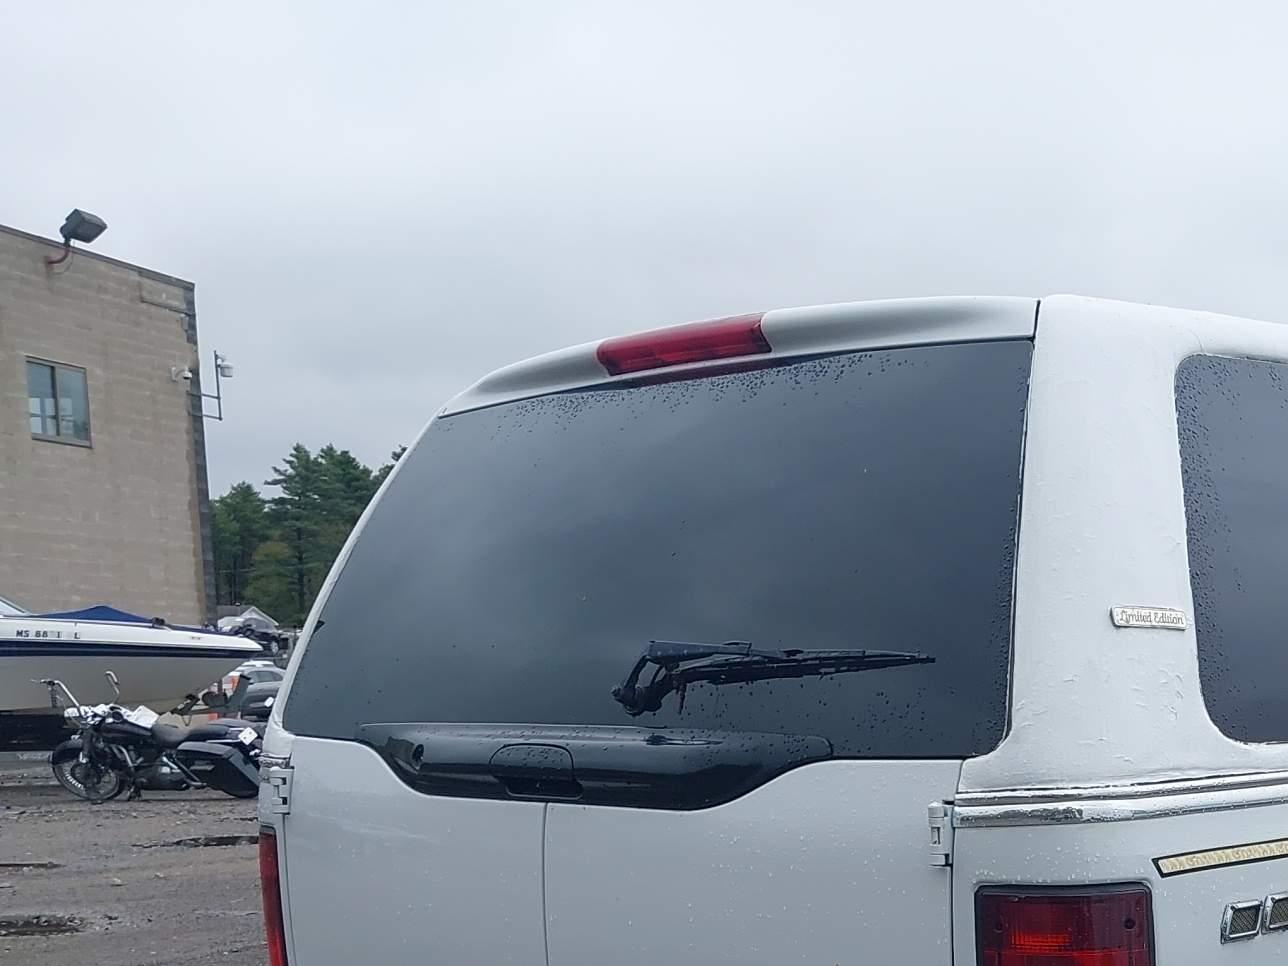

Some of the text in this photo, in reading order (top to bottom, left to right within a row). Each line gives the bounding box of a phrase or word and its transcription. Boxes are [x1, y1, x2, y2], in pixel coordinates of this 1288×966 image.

[1119, 609, 1184, 626] Limited Edition
[16, 629, 30, 638] MS
